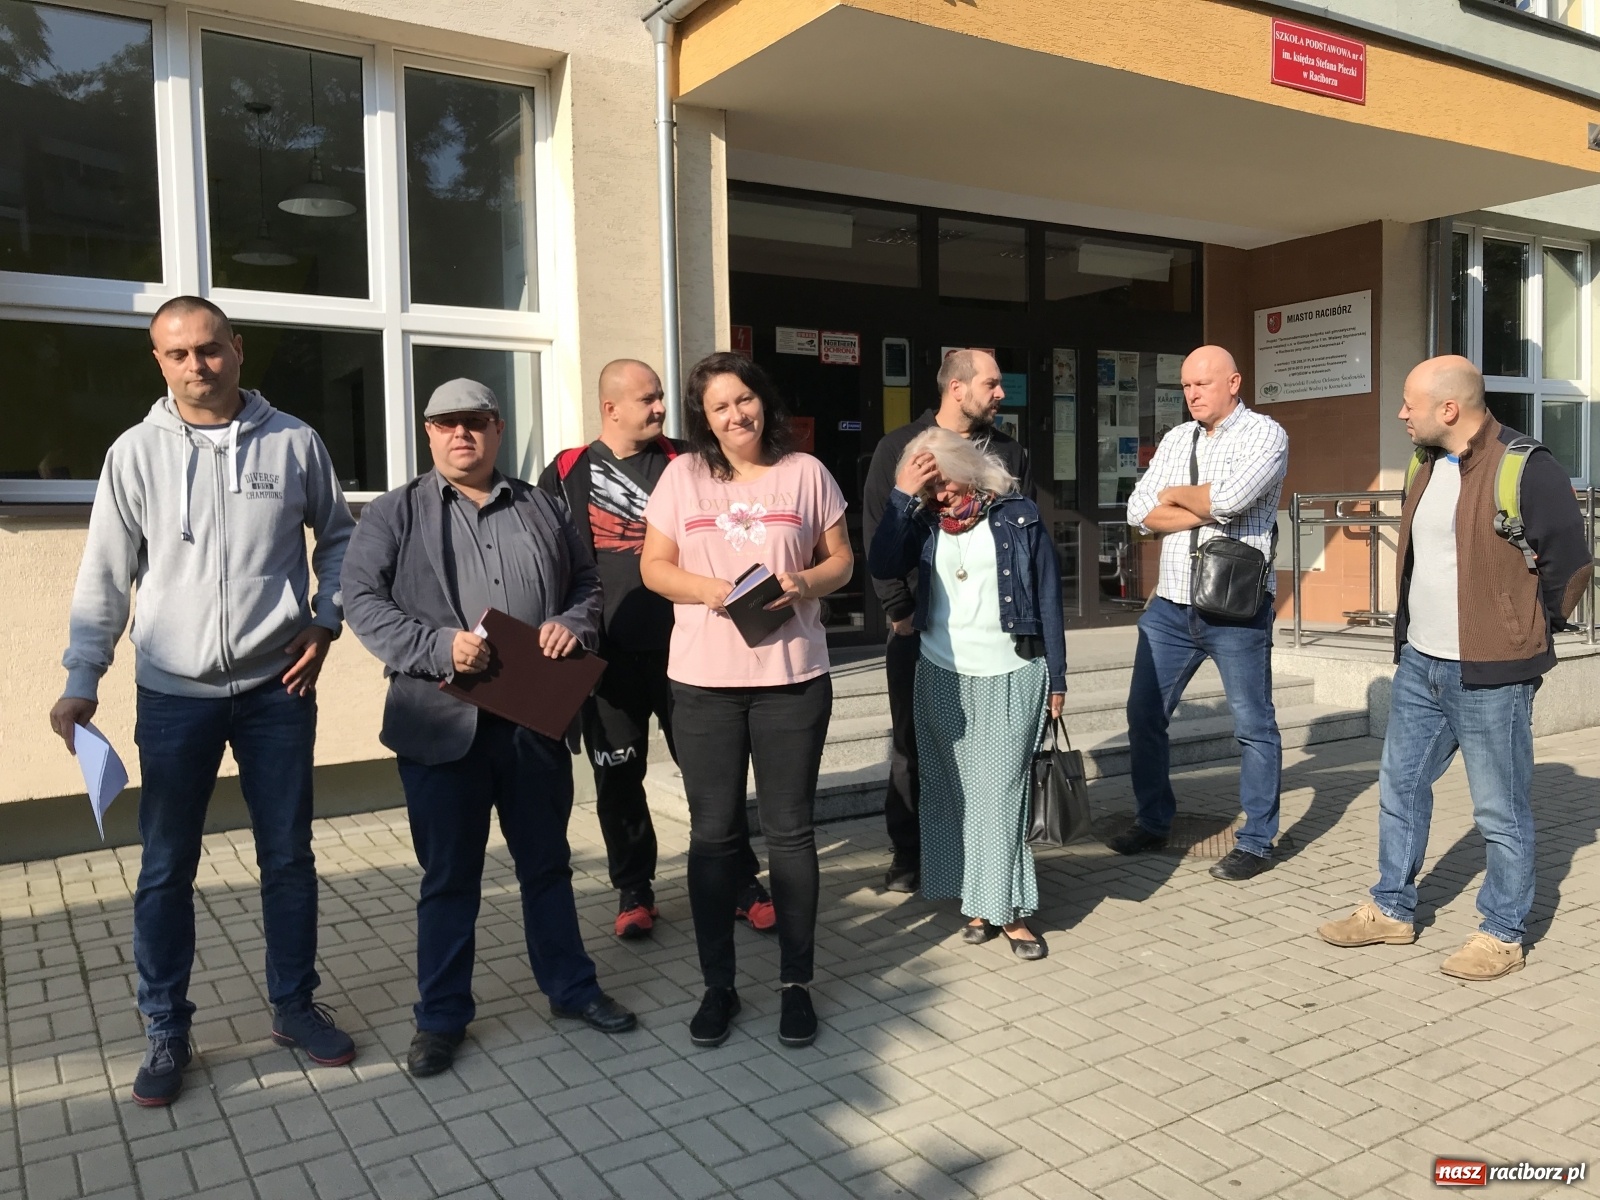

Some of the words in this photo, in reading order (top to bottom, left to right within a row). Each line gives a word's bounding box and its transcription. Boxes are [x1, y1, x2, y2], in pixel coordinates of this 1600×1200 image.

[1275, 31, 1304, 46] SZKOŁA
[1305, 38, 1351, 59] PODSTAWOWA
[1282, 49, 1292, 60] im.
[1293, 51, 1315, 66] księdza
[1316, 57, 1337, 72] Stefana
[1338, 63, 1357, 77] Pieczki
[1303, 71, 1308, 79] w
[1309, 70, 1338, 86] Raciborzu
[1286, 311, 1313, 323] MIASTO
[1315, 304, 1352, 319] RACIBÓRZ
[824, 346, 856, 355] OCHRONA
[244, 472, 280, 484] DIVERSE
[246, 491, 283, 500] CHAMPIONS
[764, 492, 796, 507] DAY
